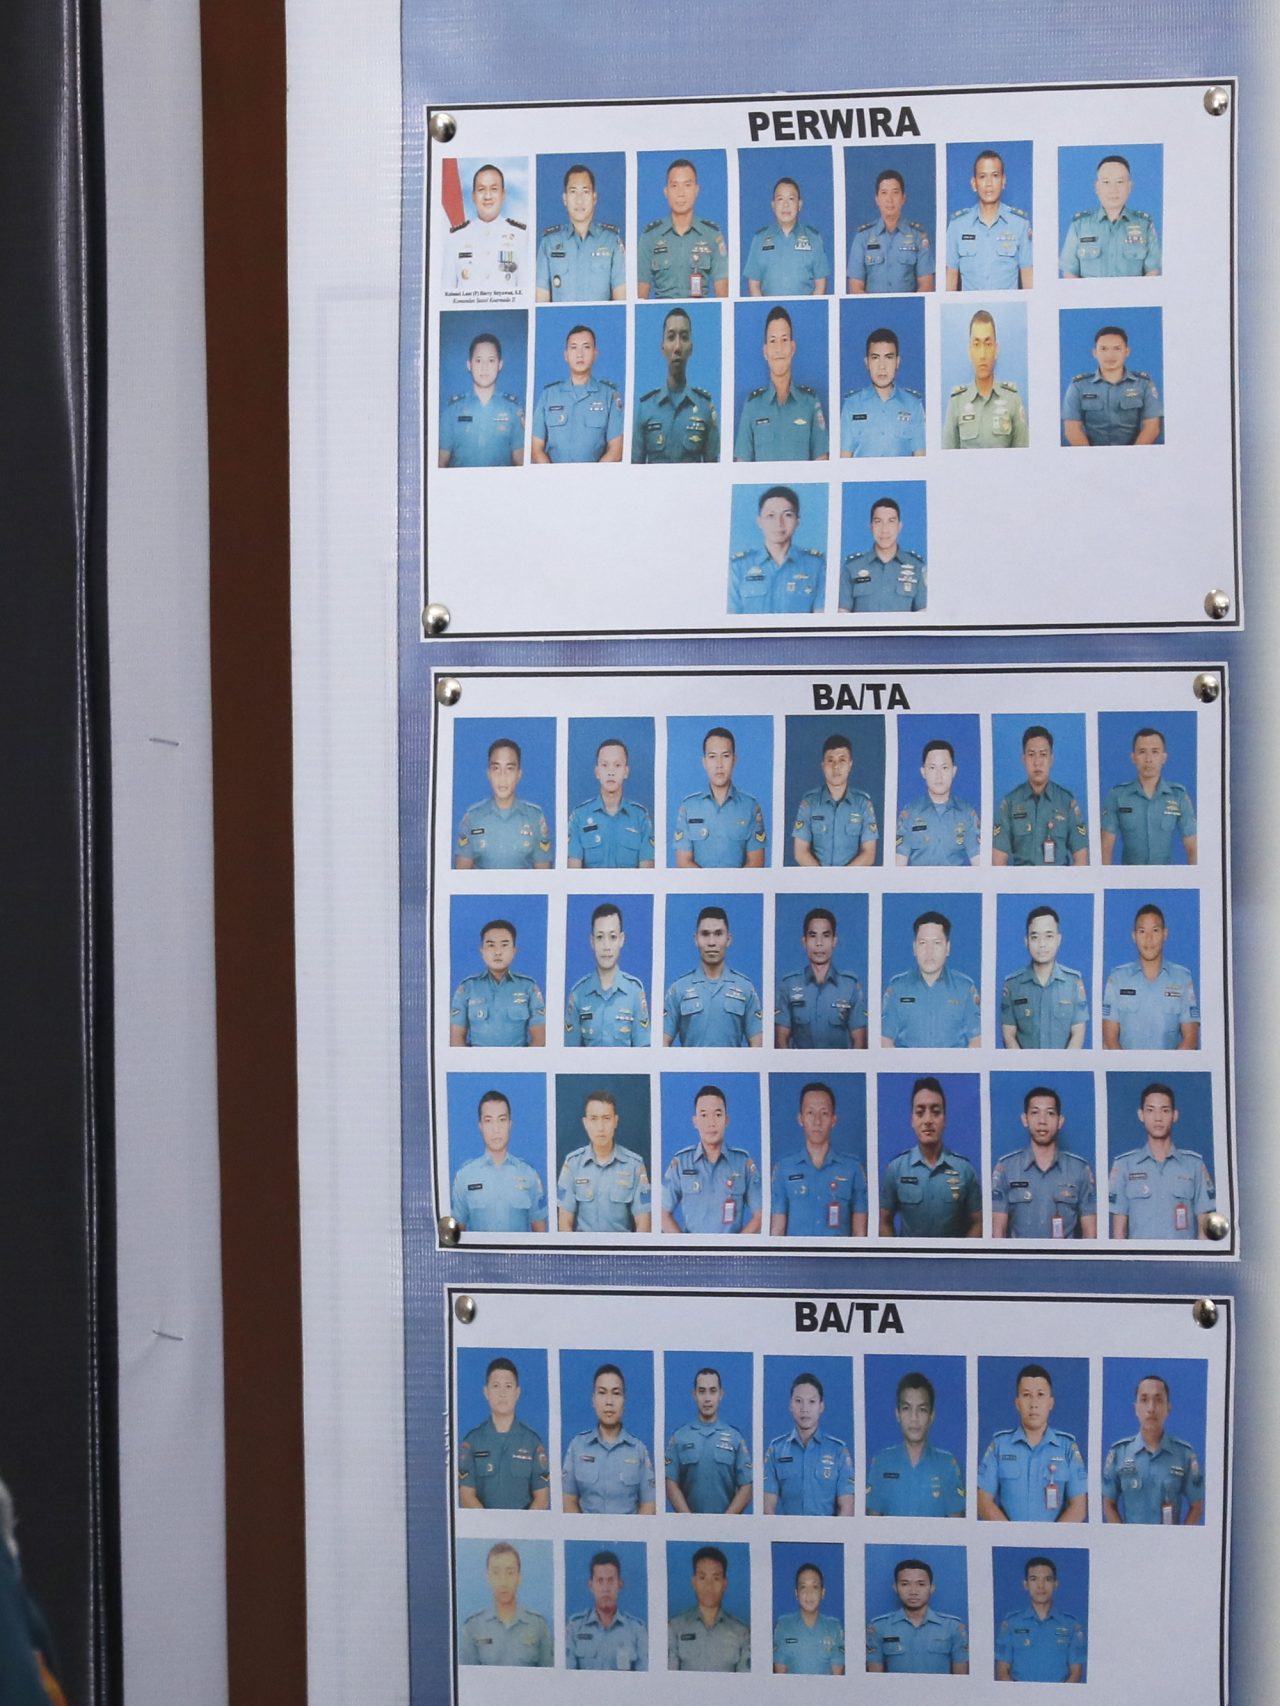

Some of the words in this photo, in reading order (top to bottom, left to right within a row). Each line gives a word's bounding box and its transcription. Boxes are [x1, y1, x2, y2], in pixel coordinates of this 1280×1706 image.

[748, 106, 922, 142] PERWIRA
[812, 682, 911, 711] BA/TA
[794, 1301, 905, 1334] BA/TA
